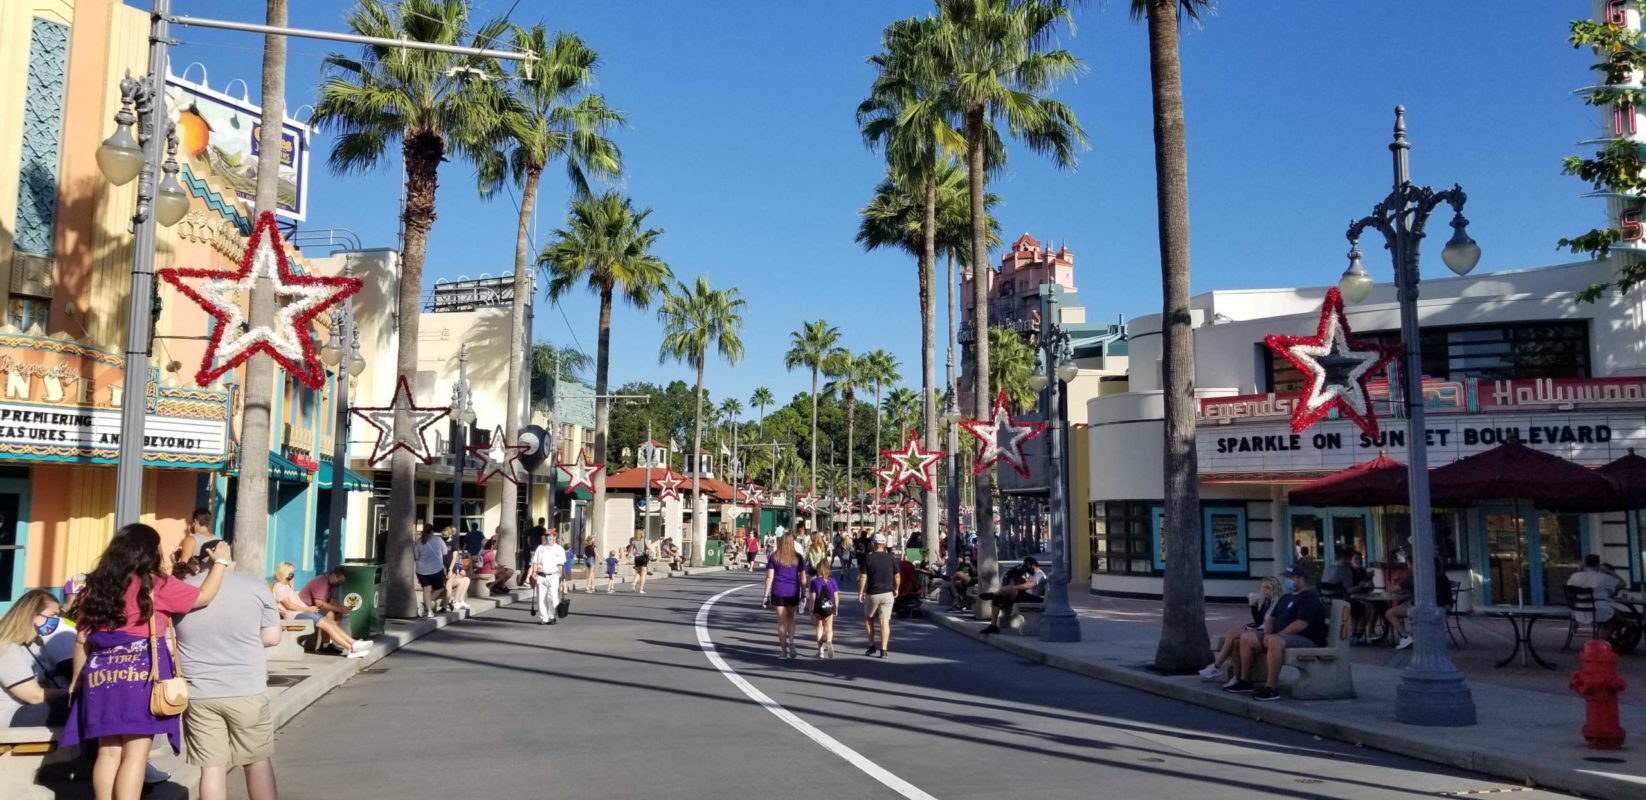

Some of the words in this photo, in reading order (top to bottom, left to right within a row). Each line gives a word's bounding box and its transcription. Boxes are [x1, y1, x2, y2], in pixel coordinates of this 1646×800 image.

[1493, 377, 1646, 410] Hollywoo
[2, 409, 92, 427] PREMIERING
[100, 432, 121, 445] AN
[144, 434, 202, 450] BEYOND!
[1217, 434, 1301, 453] SPARKLE
[1313, 432, 1341, 450] ON
[1359, 429, 1450, 449] SUNET
[1463, 425, 1612, 446] BOULEVARD
[88, 666, 149, 688] Witche
